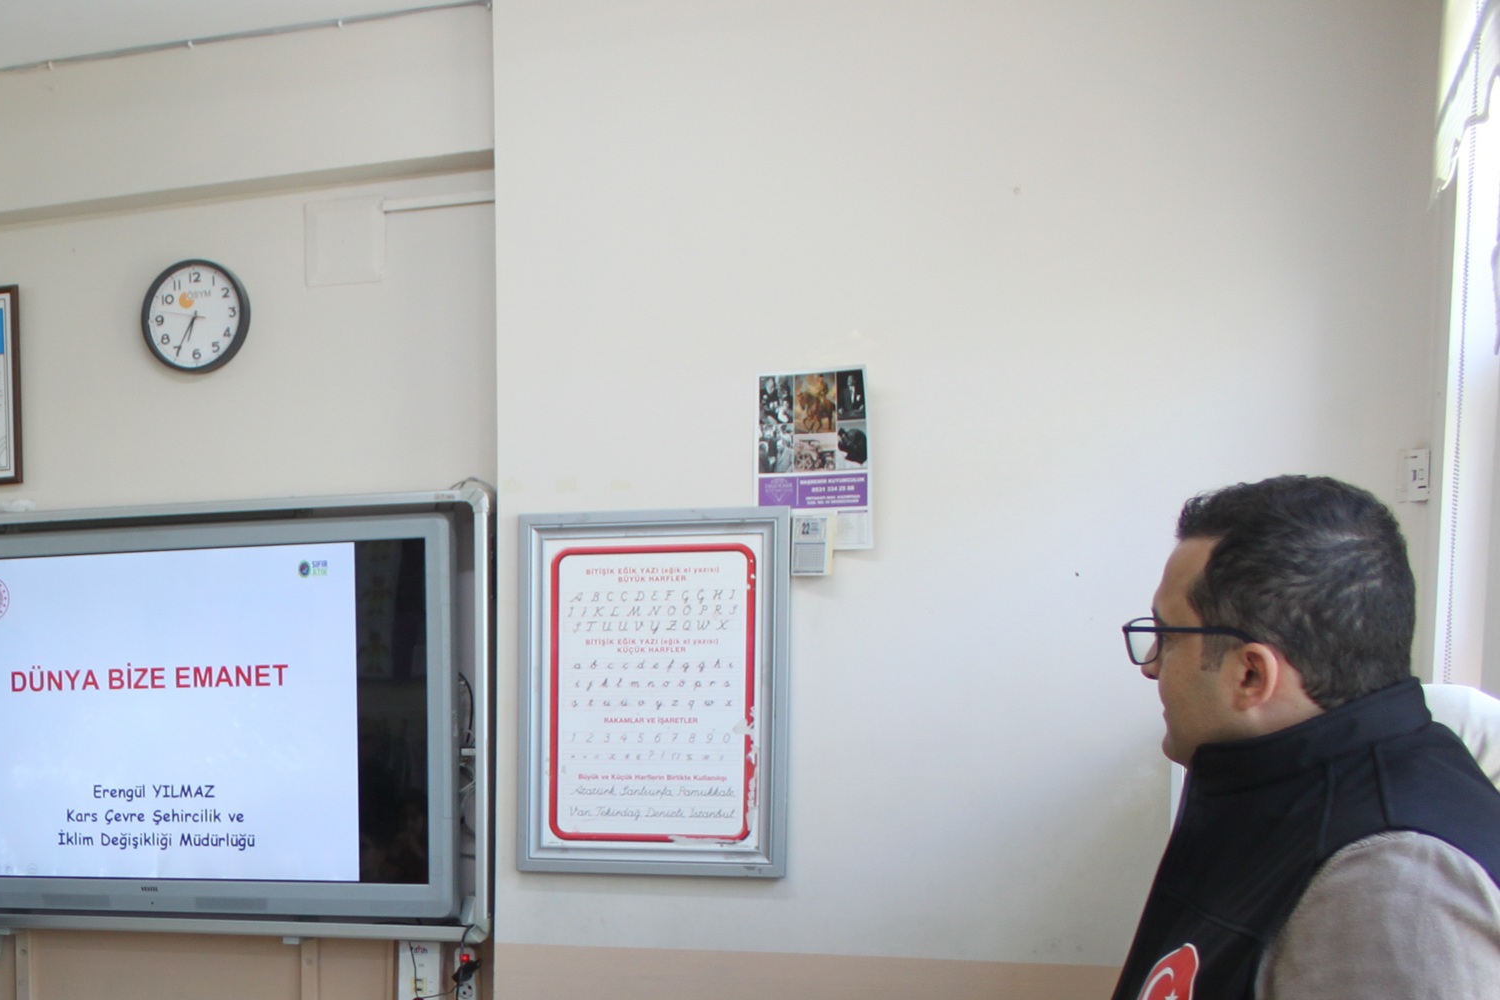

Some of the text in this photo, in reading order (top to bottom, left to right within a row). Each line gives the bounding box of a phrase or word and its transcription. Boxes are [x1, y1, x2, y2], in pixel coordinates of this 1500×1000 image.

[189, 271, 201, 283] 12
[211, 275, 215, 286] 1
[173, 280, 181, 290] 11
[221, 287, 230, 298] 2
[162, 294, 174, 305] 10
[228, 306, 237, 318] 3
[155, 315, 164, 326] 9
[223, 327, 232, 337] 4
[161, 334, 170, 345] 8
[173, 346, 182, 357] 7
[211, 342, 220, 353] 5
[192, 348, 201, 360] 6
[648, 574, 687, 582] HARFLER
[11, 663, 288, 692] DÜNYA BİZE EMANET
[657, 716, 698, 725] İŞARETLER
[93, 785, 215, 802] Erengül YILMAZ
[67, 809, 245, 825] Kars Çevre Şehircilik ve
[58, 830, 255, 851] İklim Değişikliği Müdürlüğü
